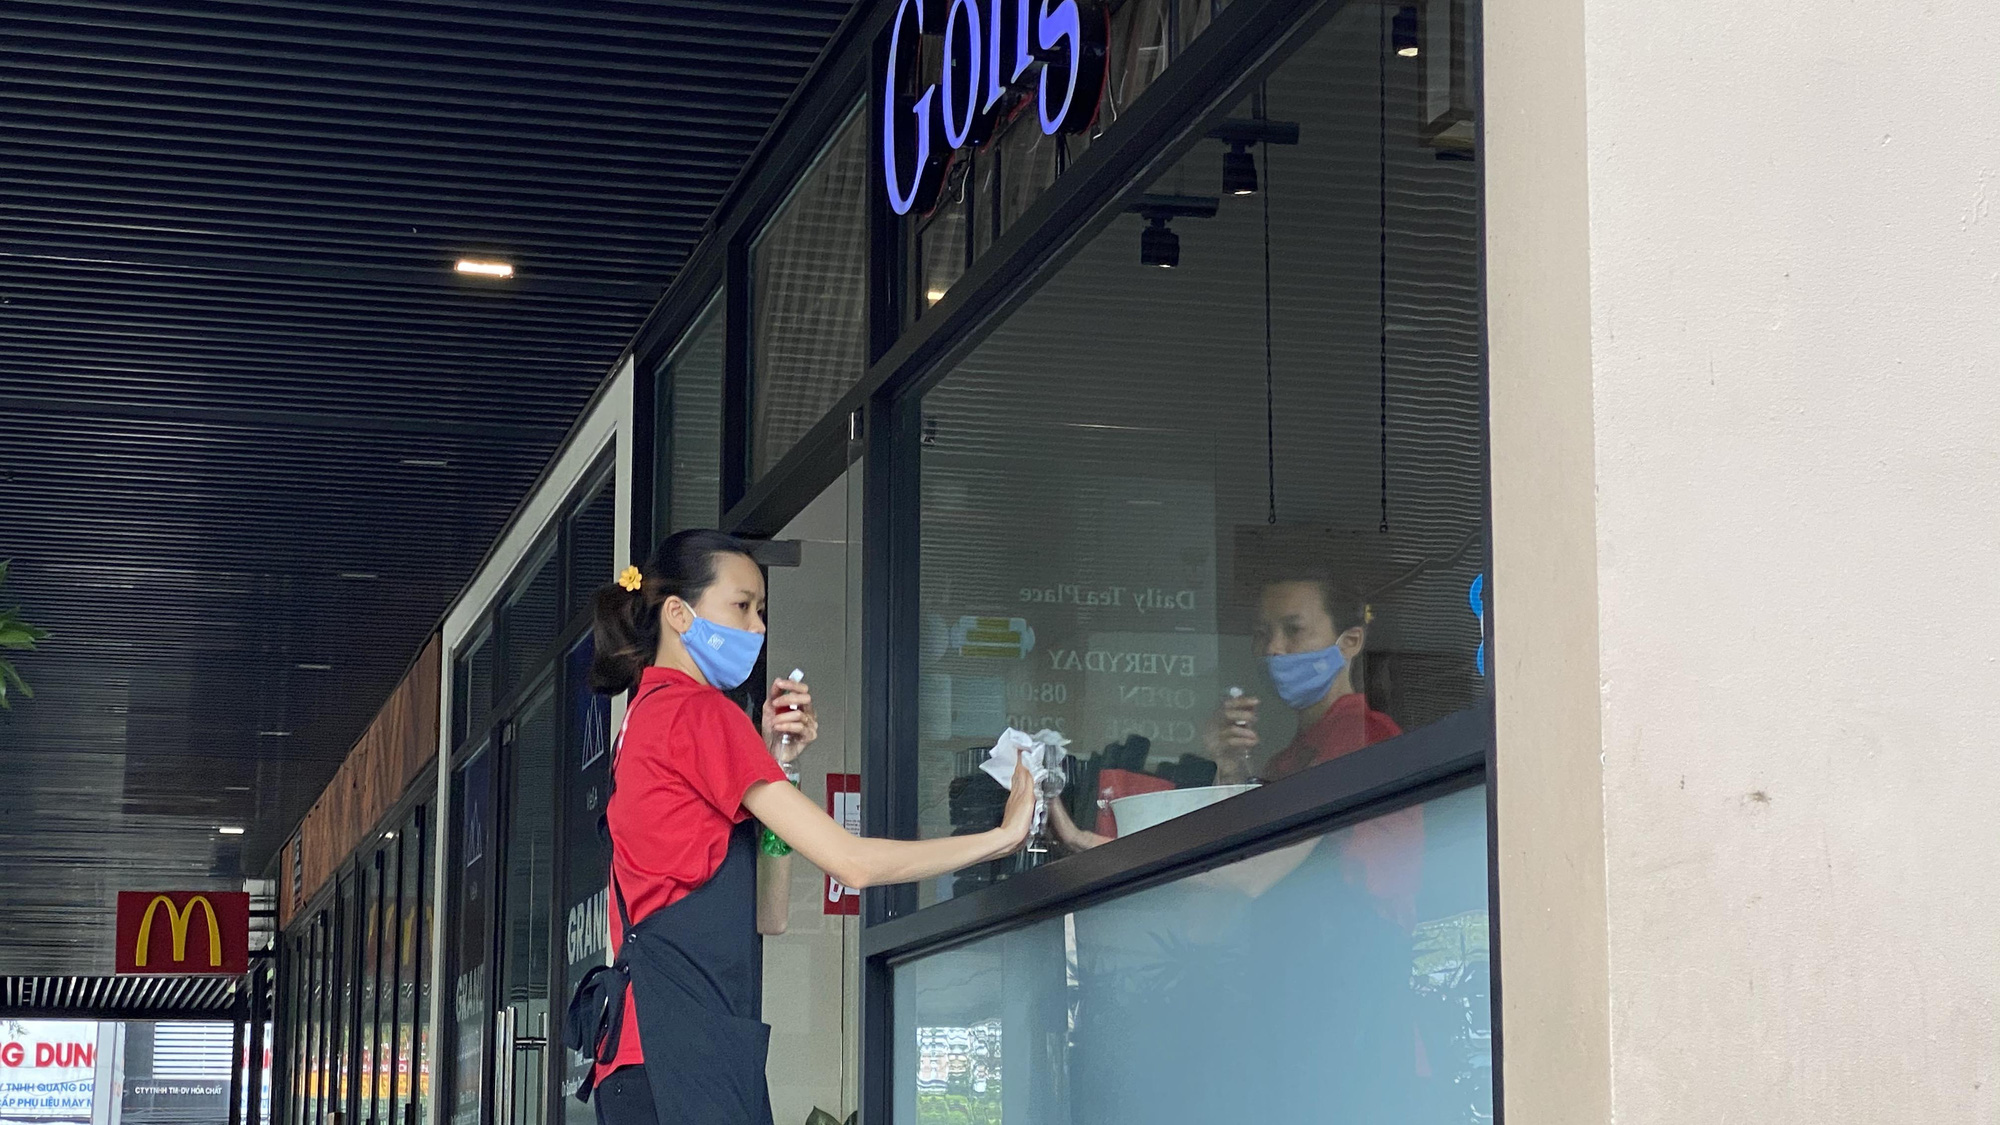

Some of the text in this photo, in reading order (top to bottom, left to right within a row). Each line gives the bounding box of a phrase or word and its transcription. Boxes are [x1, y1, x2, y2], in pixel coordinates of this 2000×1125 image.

[0, 1042, 97, 1068] G DUN
[6, 1083, 35, 1092] TNHH
[36, 1083, 77, 1092] QUANG
[0, 1094, 16, 1107] ẤP
[17, 1098, 38, 1109] PHỤ
[62, 1098, 84, 1107] MAY
